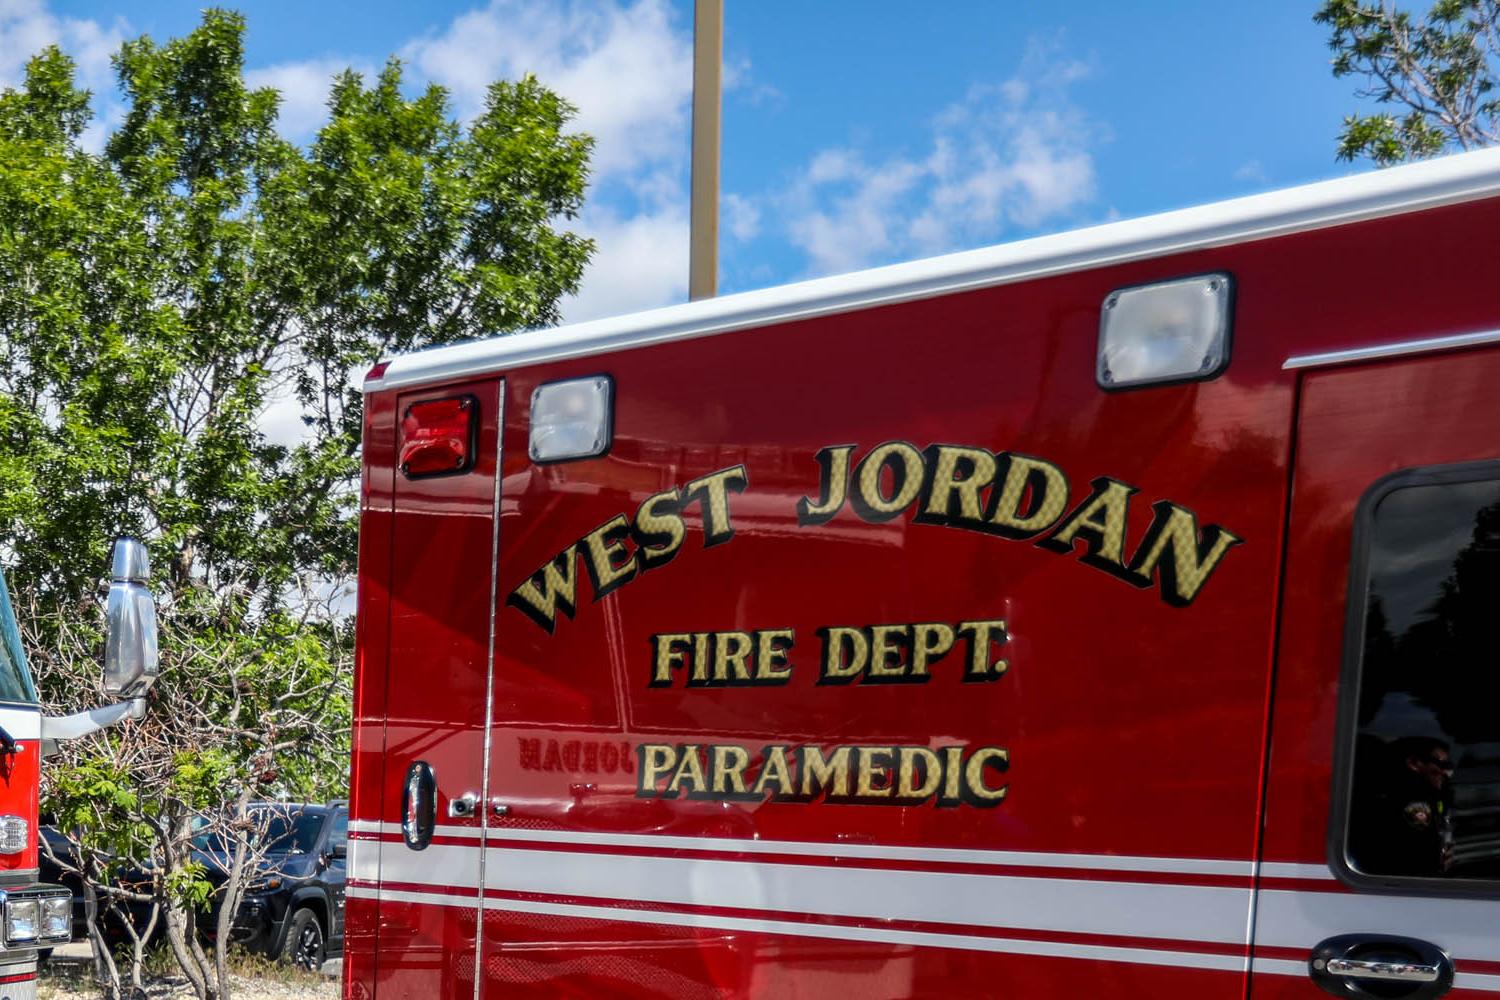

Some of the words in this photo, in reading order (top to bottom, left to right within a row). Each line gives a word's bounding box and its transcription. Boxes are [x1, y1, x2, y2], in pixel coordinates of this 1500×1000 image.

[506, 465, 748, 634] WEST
[799, 441, 1243, 607] JORDAN
[649, 627, 794, 688] FIRE
[815, 620, 1009, 686] DEPT.
[634, 743, 1010, 808] PARAMEDIC
